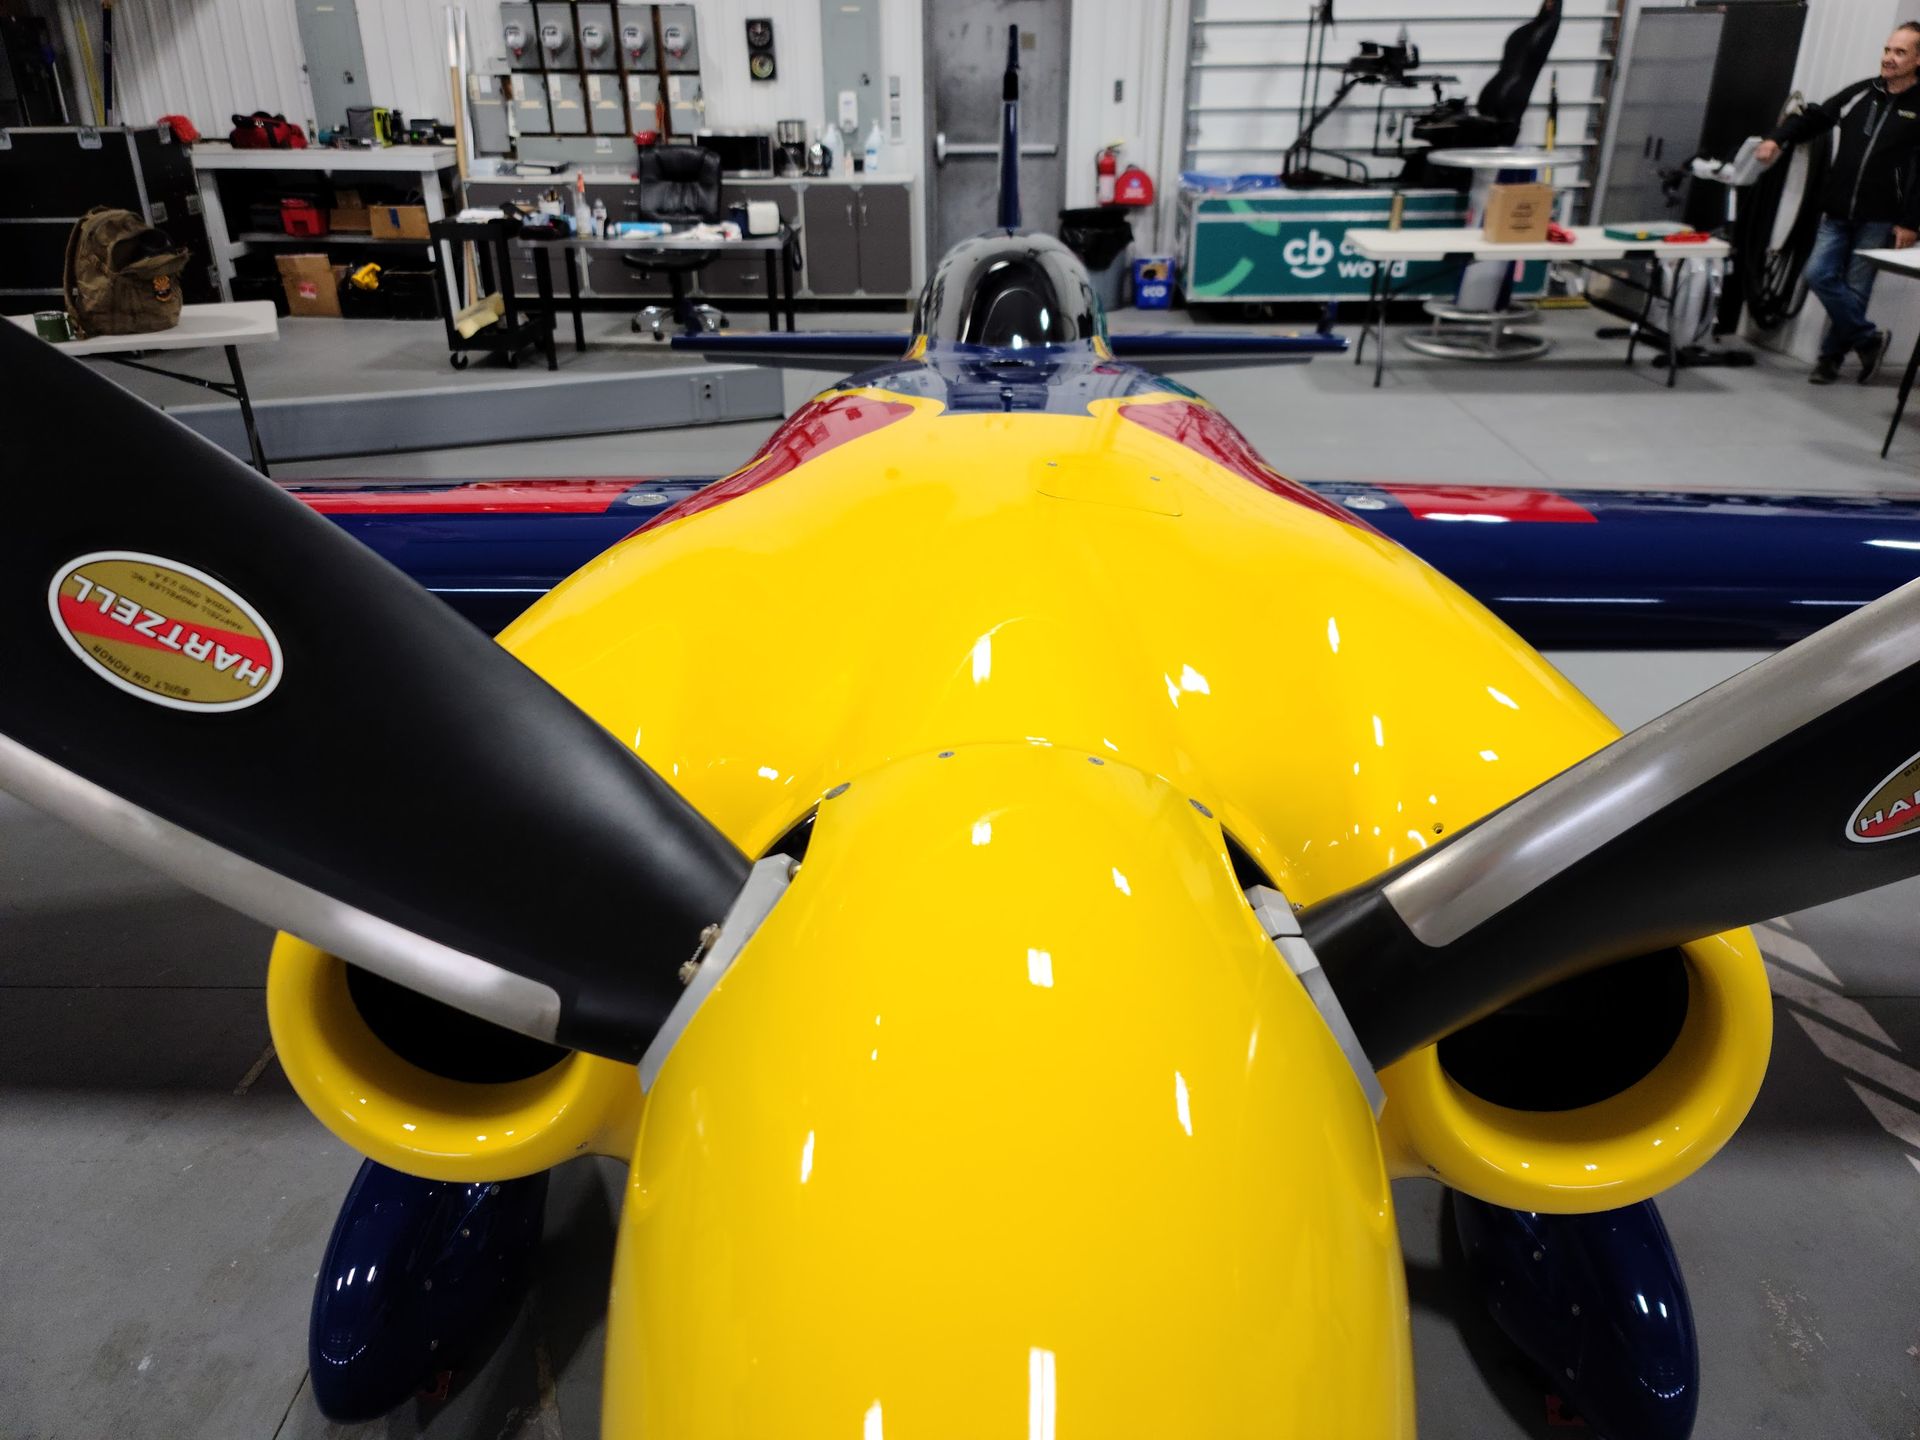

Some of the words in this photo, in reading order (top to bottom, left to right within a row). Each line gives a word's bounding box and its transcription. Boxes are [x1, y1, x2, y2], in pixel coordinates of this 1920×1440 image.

[1283, 229, 1334, 265] cb
[72, 573, 268, 687] HARTZELL
[92, 645, 132, 673] HONOR
[134, 671, 151, 684] ON
[154, 681, 191, 696] BUILT
